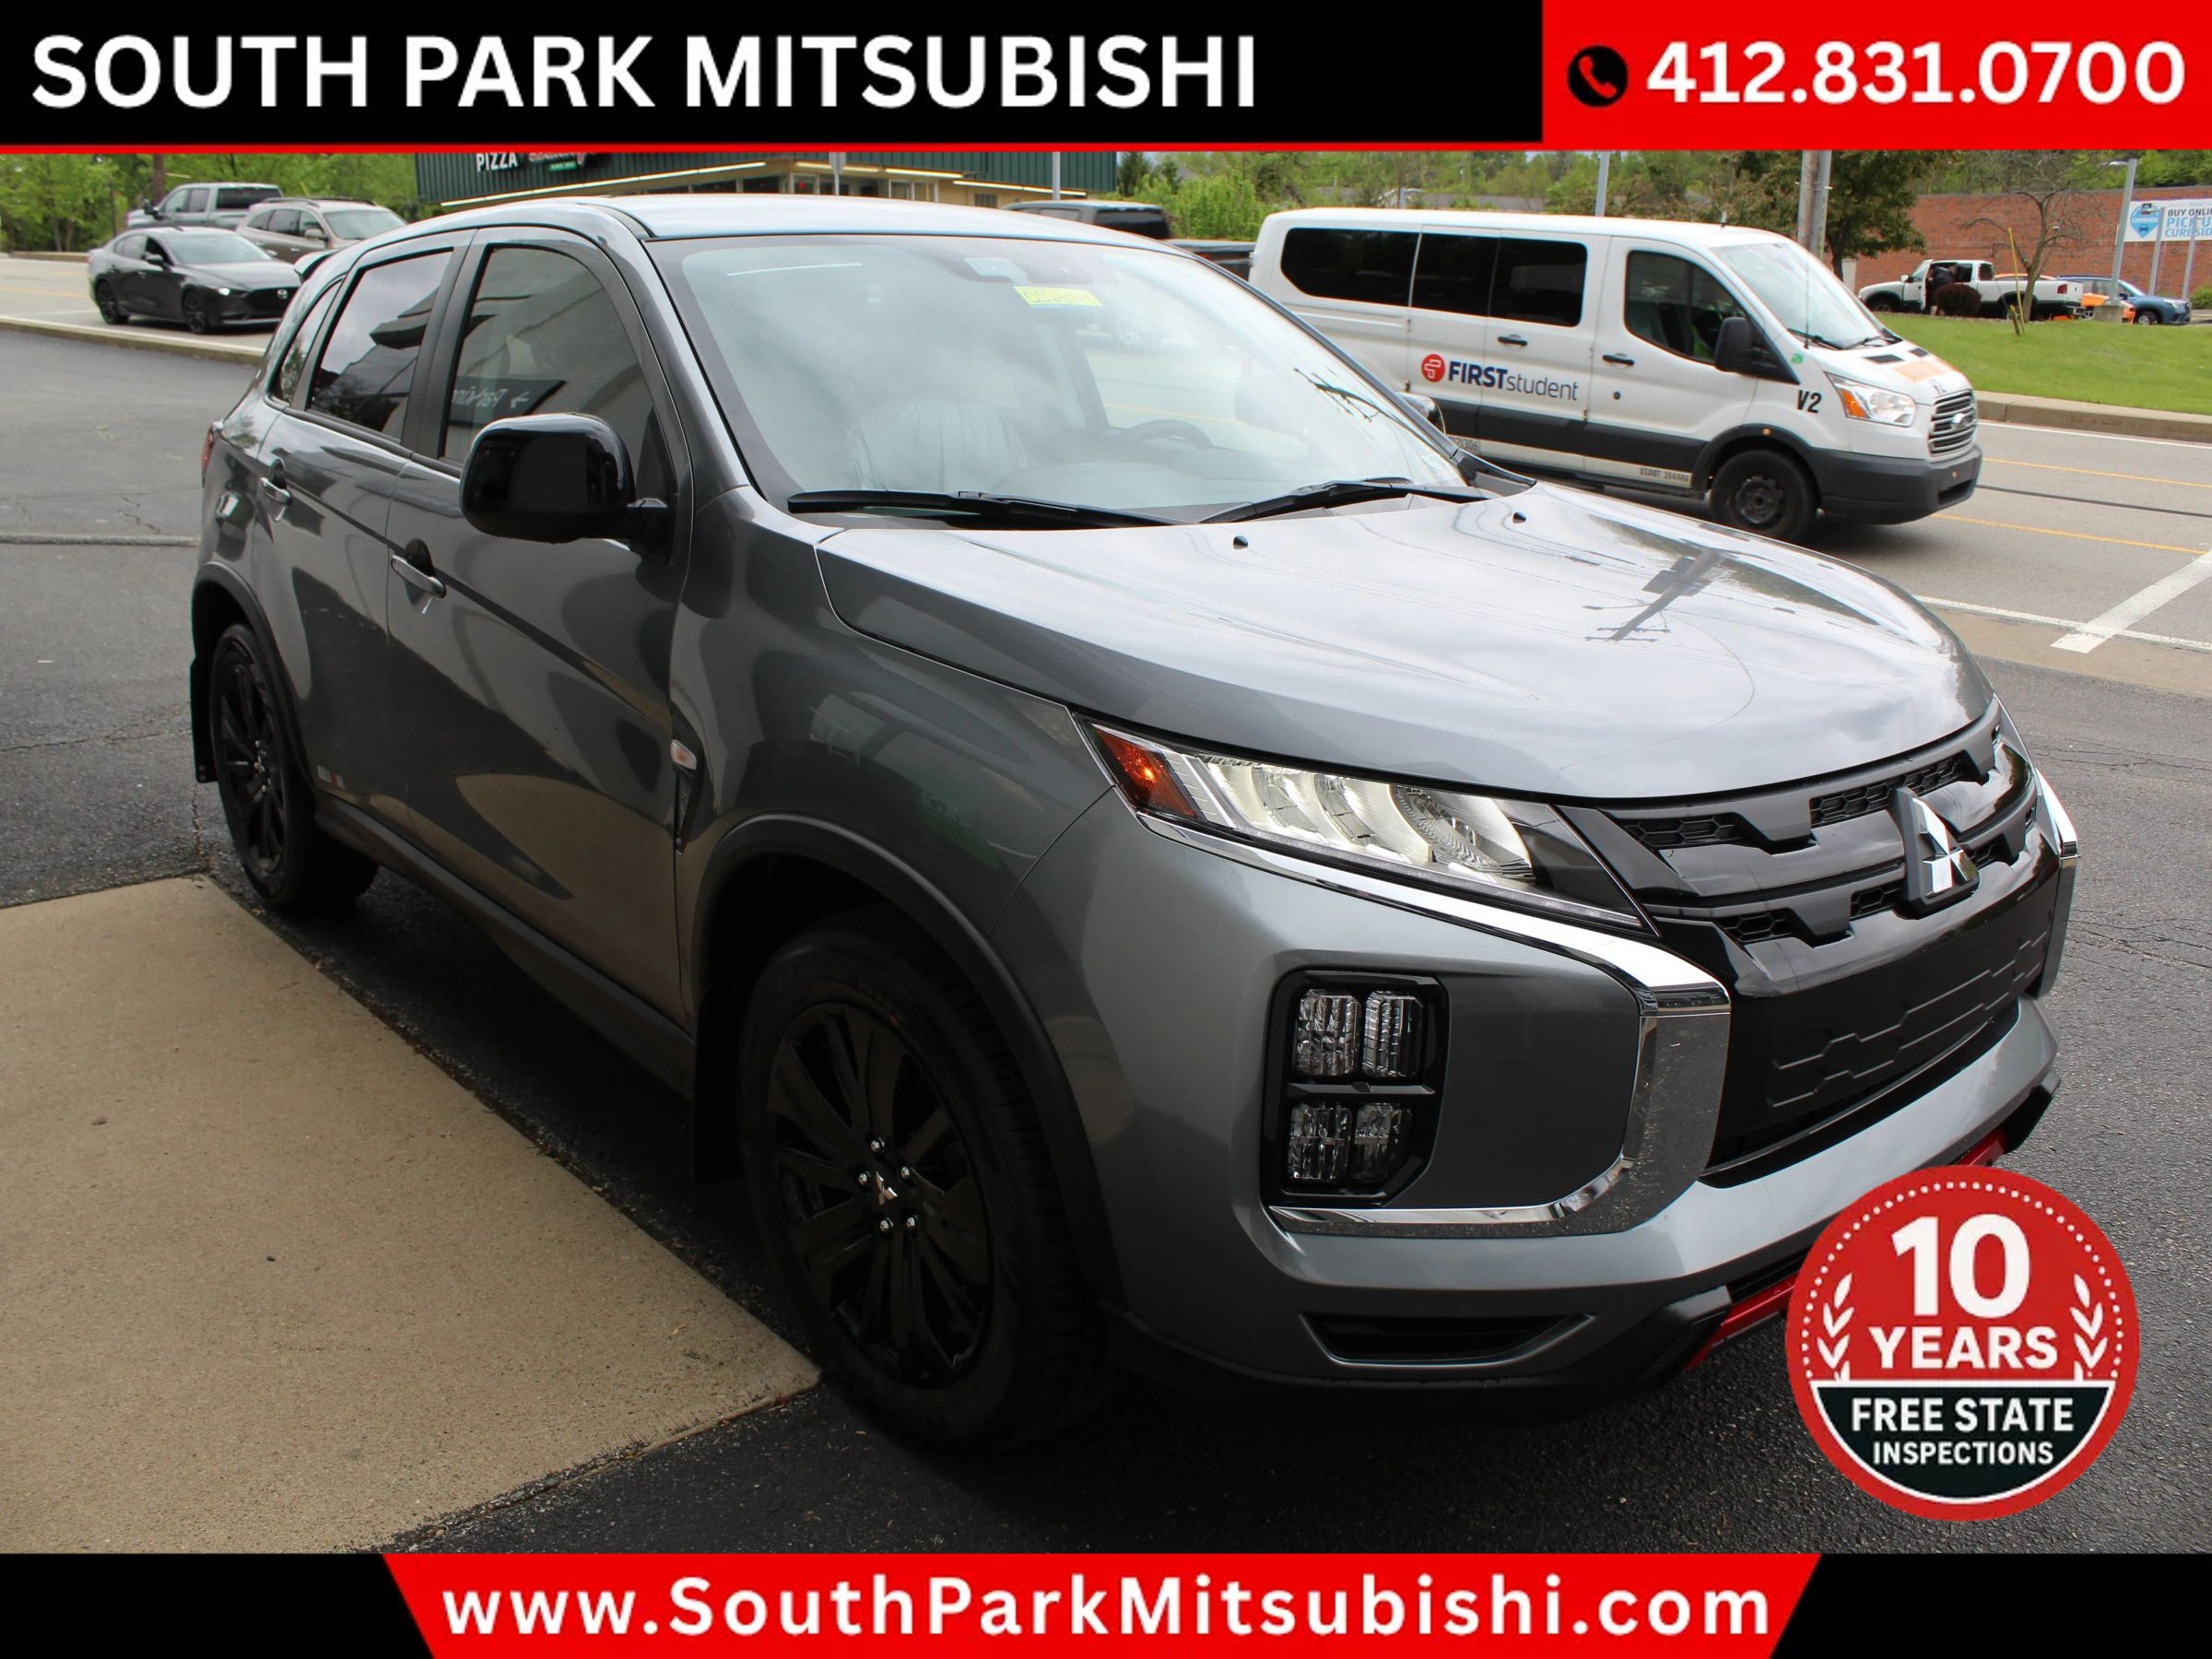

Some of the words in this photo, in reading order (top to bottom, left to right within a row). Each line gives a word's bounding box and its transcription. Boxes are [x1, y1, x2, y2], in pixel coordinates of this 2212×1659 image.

[476, 152, 518, 172] PIZZA
[2168, 208, 2186, 217] BUY
[1797, 389, 1822, 414] V2
